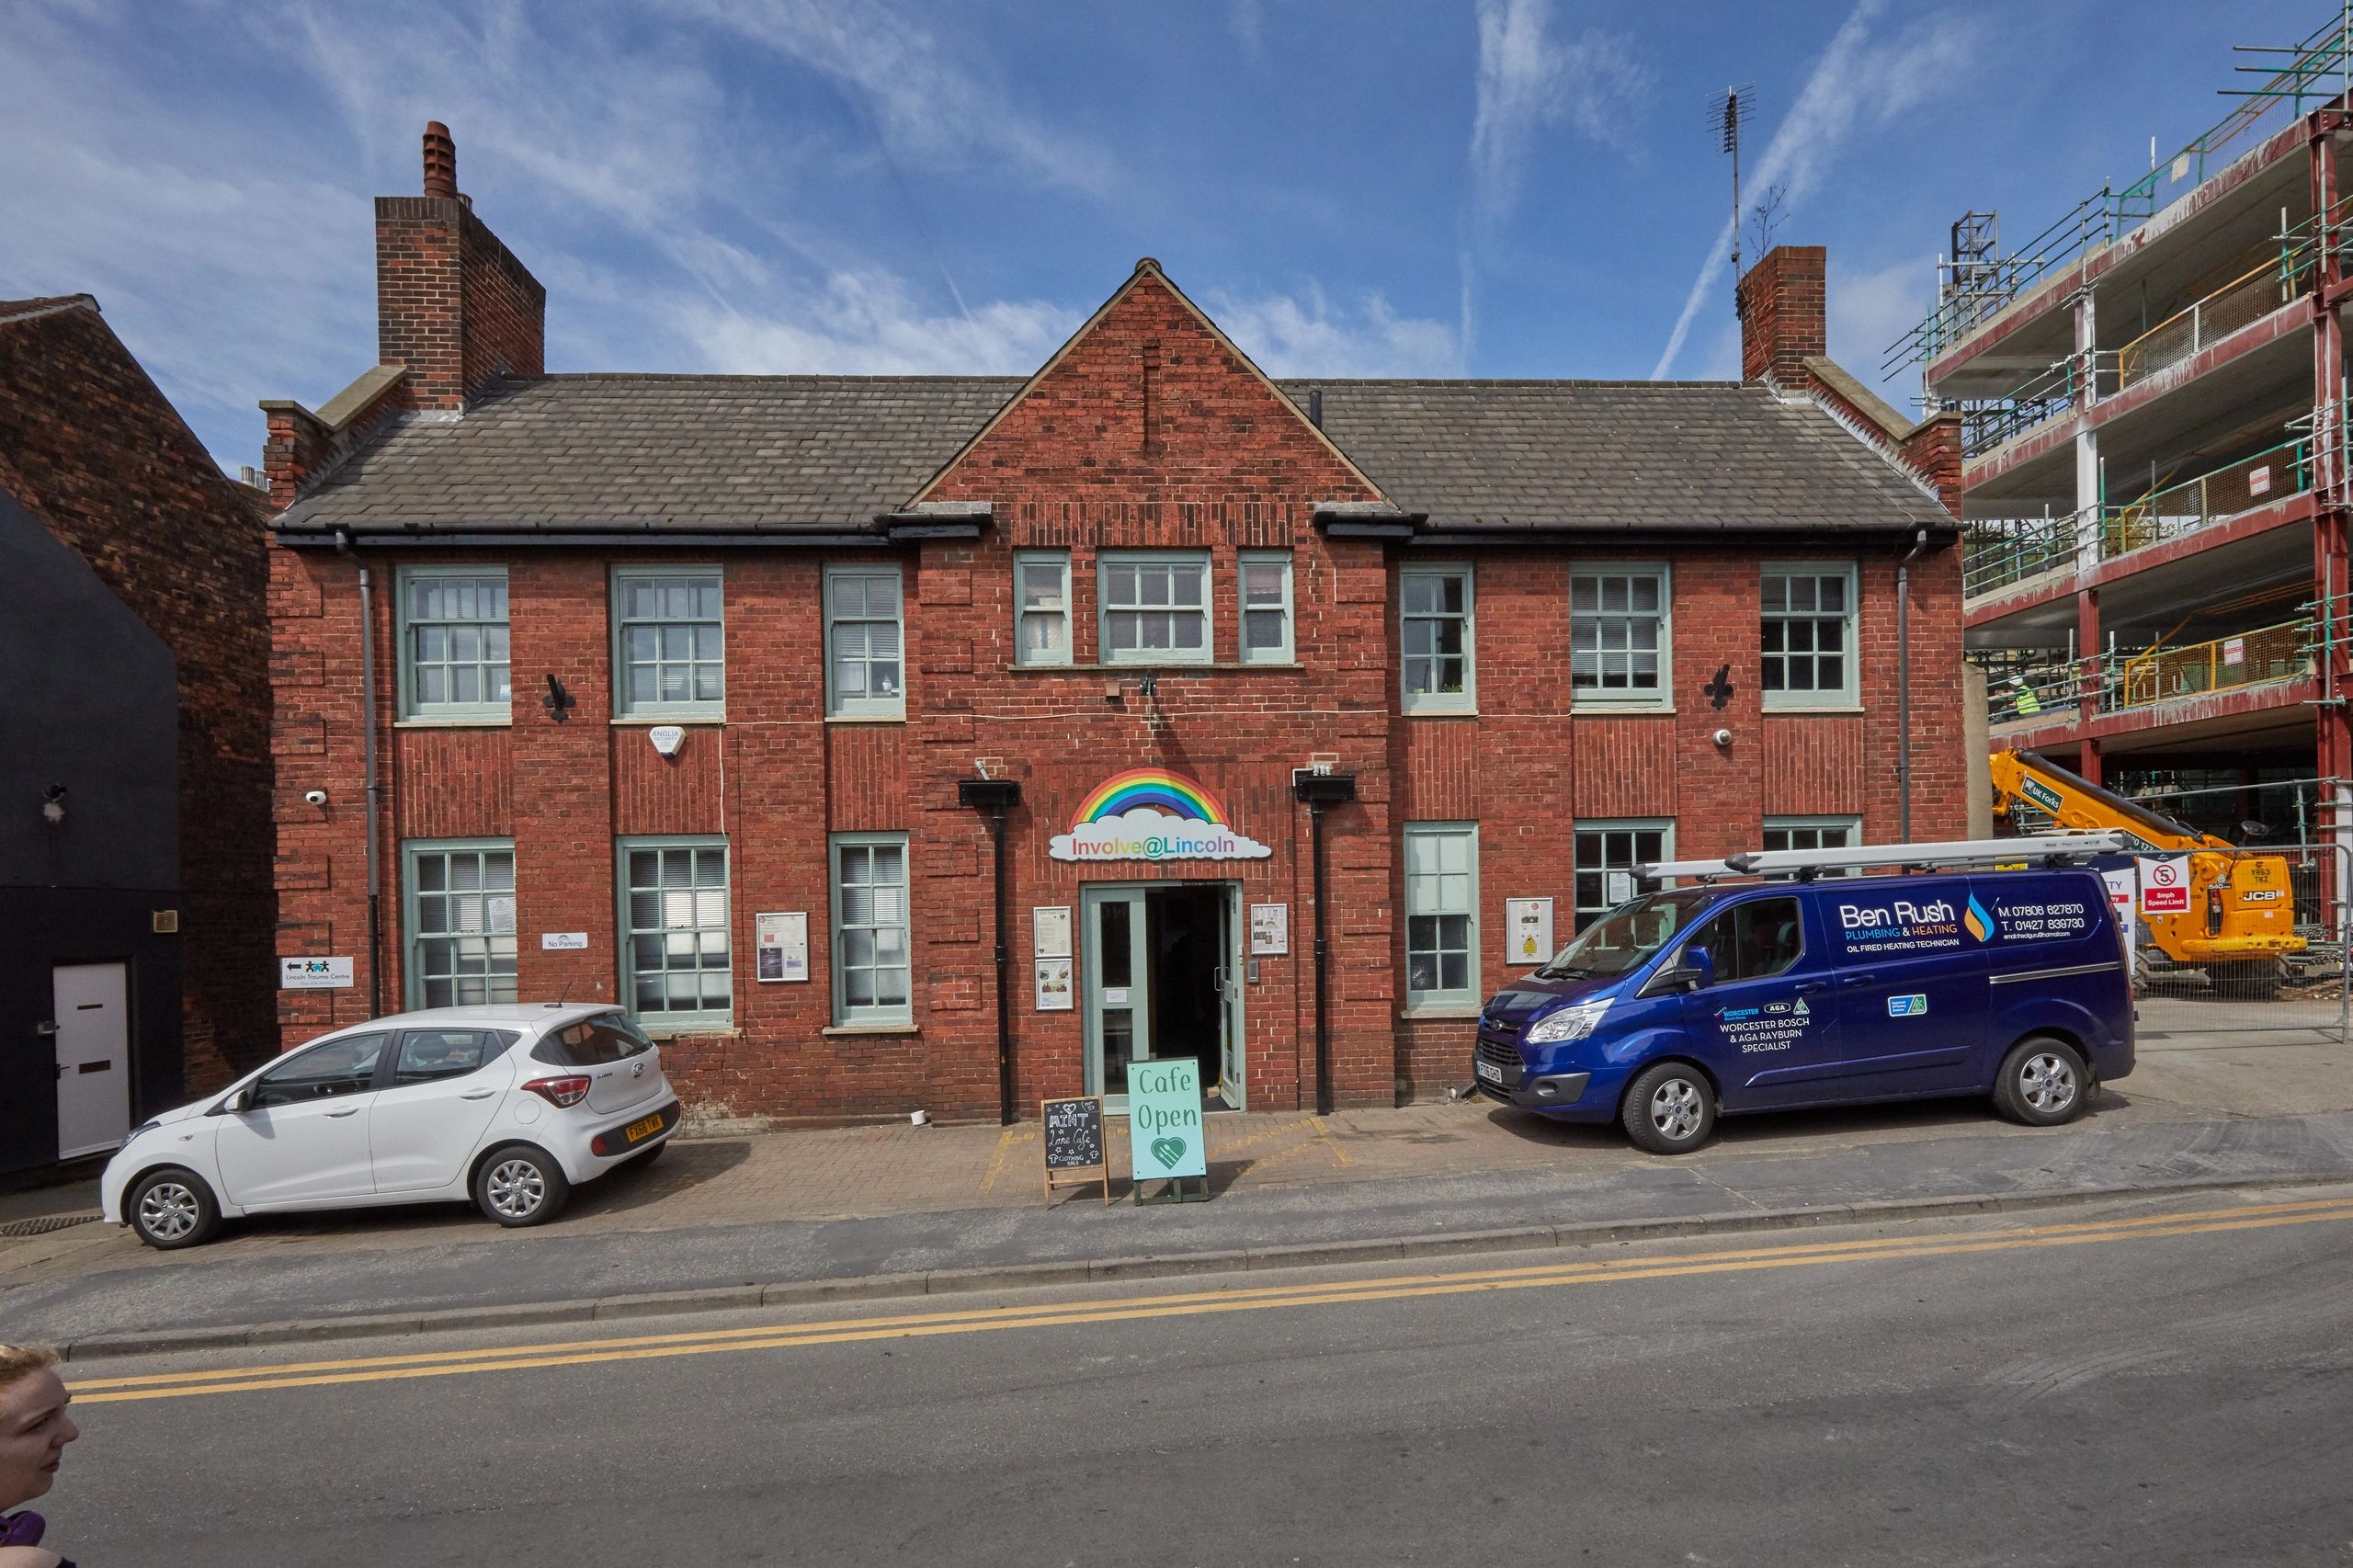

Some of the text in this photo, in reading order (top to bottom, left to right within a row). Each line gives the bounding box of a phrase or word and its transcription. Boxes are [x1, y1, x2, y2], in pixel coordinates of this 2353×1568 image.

[2032, 787, 2060, 809] UK Forks
[1072, 835, 1235, 858] Involve@Lincoln
[2243, 891, 2276, 901] JCB
[1839, 899, 1955, 928] Ben Rush
[2012, 905, 2044, 917] 07806
[2046, 903, 2084, 915] 627870
[2015, 920, 2043, 931] 01427
[2047, 917, 2085, 929] 839730
[1845, 924, 1958, 940] PLUMBING & HEATING
[1847, 938, 1960, 953] OIL FIRED HEATING TECHNICIAN
[1723, 1008, 1759, 1017] WORCESTER
[1720, 1017, 1810, 1033] WORCESTER BOSCH
[1730, 1029, 1802, 1043] & AGA RAYBURN
[1742, 1040, 1791, 1053] SPECIALIST
[1139, 1066, 1191, 1094] Cafe
[1049, 1113, 1088, 1128] MINT
[1138, 1104, 1197, 1135] Open
[1048, 1128, 1091, 1151] Lane Cafe
